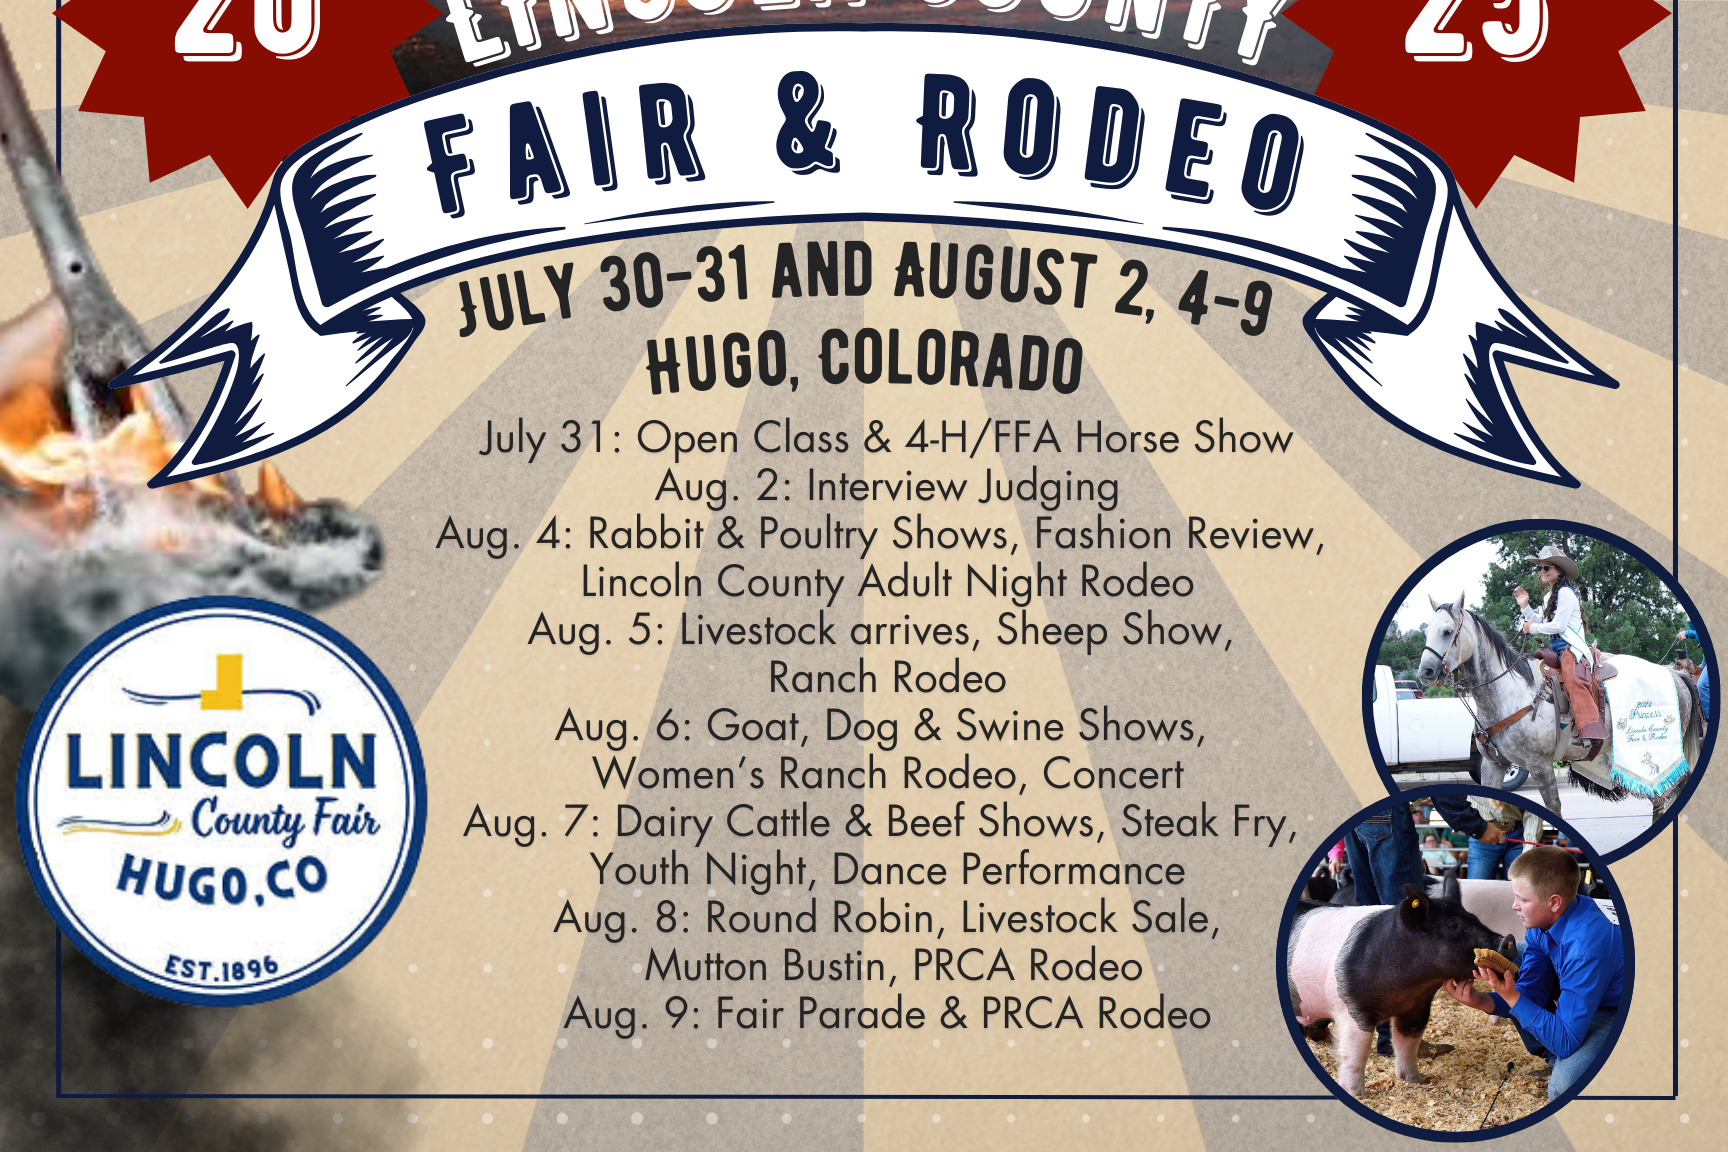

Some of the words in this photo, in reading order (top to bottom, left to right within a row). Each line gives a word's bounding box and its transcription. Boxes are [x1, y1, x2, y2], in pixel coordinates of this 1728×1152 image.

[424, 83, 705, 218] FAIR
[776, 71, 840, 175] &
[916, 74, 1304, 216] RODEO
[459, 263, 573, 337] JULY
[601, 245, 747, 311] 30-31
[772, 241, 871, 298] AND
[894, 242, 1097, 308] AUGUST
[1115, 260, 1154, 324] 2,
[1179, 270, 1272, 336] 4-9
[646, 330, 798, 394] HUGO,
[818, 328, 1082, 394] COLORADO
[479, 418, 546, 463] July
[562, 420, 619, 452] 31:
[638, 420, 737, 463] Open
[754, 418, 848, 452] Class
[865, 420, 891, 452] &
[905, 418, 1061, 458] 4-H/FFA
[1078, 421, 1179, 452] Horse
[1195, 418, 1293, 452] Show
[655, 468, 738, 511] Aug.
[757, 468, 789, 500] 2:
[810, 469, 967, 500] Interview
[978, 466, 1117, 511] Judging
[436, 516, 519, 559] Aug.
[537, 517, 570, 548] 4:
[591, 514, 703, 548] Rabbit
[718, 516, 744, 548] &
[761, 514, 877, 559] Poultry
[893, 514, 1017, 555] Shows,
[1037, 514, 1170, 548] Fashion
[1189, 517, 1323, 555] Review,
[584, 562, 701, 596] Lincoln
[718, 564, 844, 607] County
[858, 562, 952, 596] Adult
[968, 562, 1067, 607] Night
[1082, 562, 1193, 596] Rodeo
[528, 613, 611, 655] Aug.
[629, 613, 662, 644] 5:
[683, 610, 836, 645] Livestock
[851, 615, 979, 651] arrives,
[998, 610, 1107, 655] Sheep
[1124, 610, 1231, 651] Show,
[771, 658, 875, 692] Ranch
[895, 658, 1005, 692] Rodeo
[555, 708, 638, 751] Aug.
[657, 708, 689, 740] 6:
[708, 708, 807, 747] Goat,
[827, 709, 897, 751] Dog
[915, 708, 941, 740] &
[957, 708, 1063, 740] Swine
[1080, 706, 1204, 747] Shows,
[68, 732, 376, 789] LINCOLN
[593, 756, 763, 789] Women’s
[781, 754, 885, 788] Ranch
[905, 754, 1026, 795] Rodeo,
[1044, 756, 1184, 788] Concert
[192, 796, 305, 848] County
[314, 797, 380, 835] Fair
[463, 804, 546, 847] Aug.
[565, 805, 598, 836] 7:
[618, 805, 712, 847] Dairy
[727, 802, 829, 836] Cattle
[846, 804, 872, 836] &
[889, 801, 964, 836] Beef
[979, 802, 1103, 843] Shows,
[1122, 802, 1218, 836] Steak
[1235, 805, 1295, 847] Fry,
[117, 854, 327, 906] HUGO,CO
[590, 850, 688, 884] Youth
[707, 850, 815, 895] Night,
[835, 853, 946, 884] Dance
[964, 849, 1184, 884] Performance
[554, 900, 636, 943] Aug.
[657, 900, 688, 932] 8:
[708, 898, 816, 932] Round
[835, 898, 944, 939] Robin,
[964, 898, 1117, 932] Livestock
[1133, 898, 1218, 939] Sale,
[164, 954, 279, 982] EST.1896
[646, 948, 766, 981] Mutton
[785, 949, 896, 987] Bustin,
[916, 948, 1015, 980] PRCA
[1031, 946, 1142, 980] Rodeo
[564, 996, 647, 1039] Aug.
[666, 996, 698, 1028] 9:
[718, 997, 784, 1028] Fair
[800, 994, 925, 1028] Parade
[941, 996, 967, 1028] &
[984, 996, 1083, 1028] PRCA
[1100, 994, 1210, 1028] Rodeo
